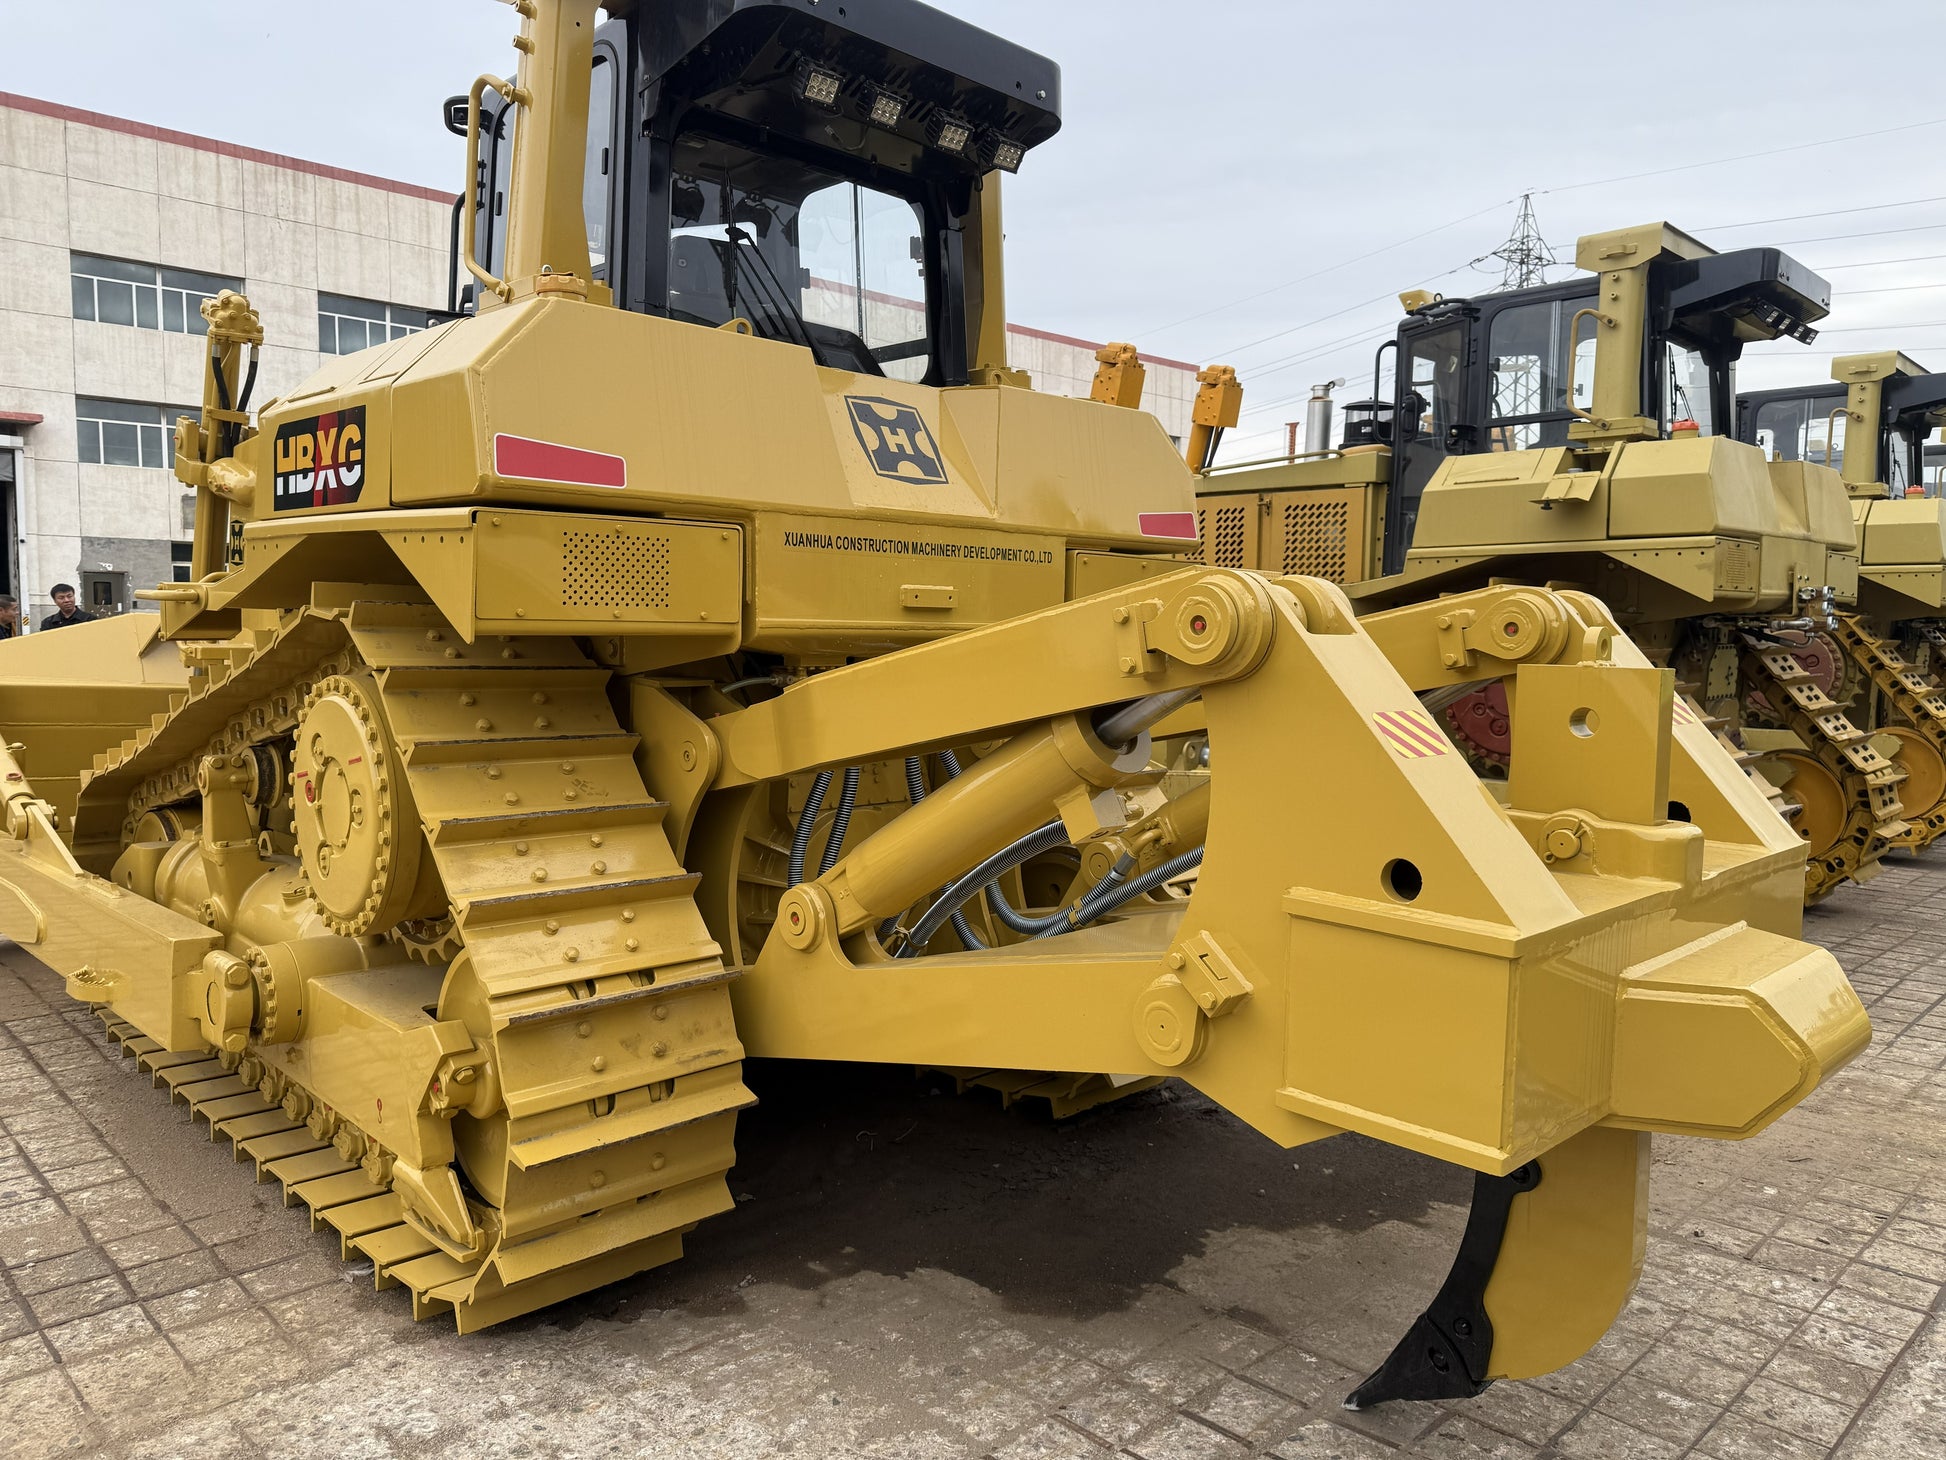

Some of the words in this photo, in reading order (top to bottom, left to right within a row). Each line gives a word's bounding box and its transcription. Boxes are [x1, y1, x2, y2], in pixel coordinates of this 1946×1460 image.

[276, 423, 362, 496] HBXG
[784, 531, 833, 549] XUANHUA
[835, 536, 909, 554] CONSTRUCTION
[911, 541, 962, 558] MACHINERY
[963, 545, 1022, 562] DEVELOPMENT
